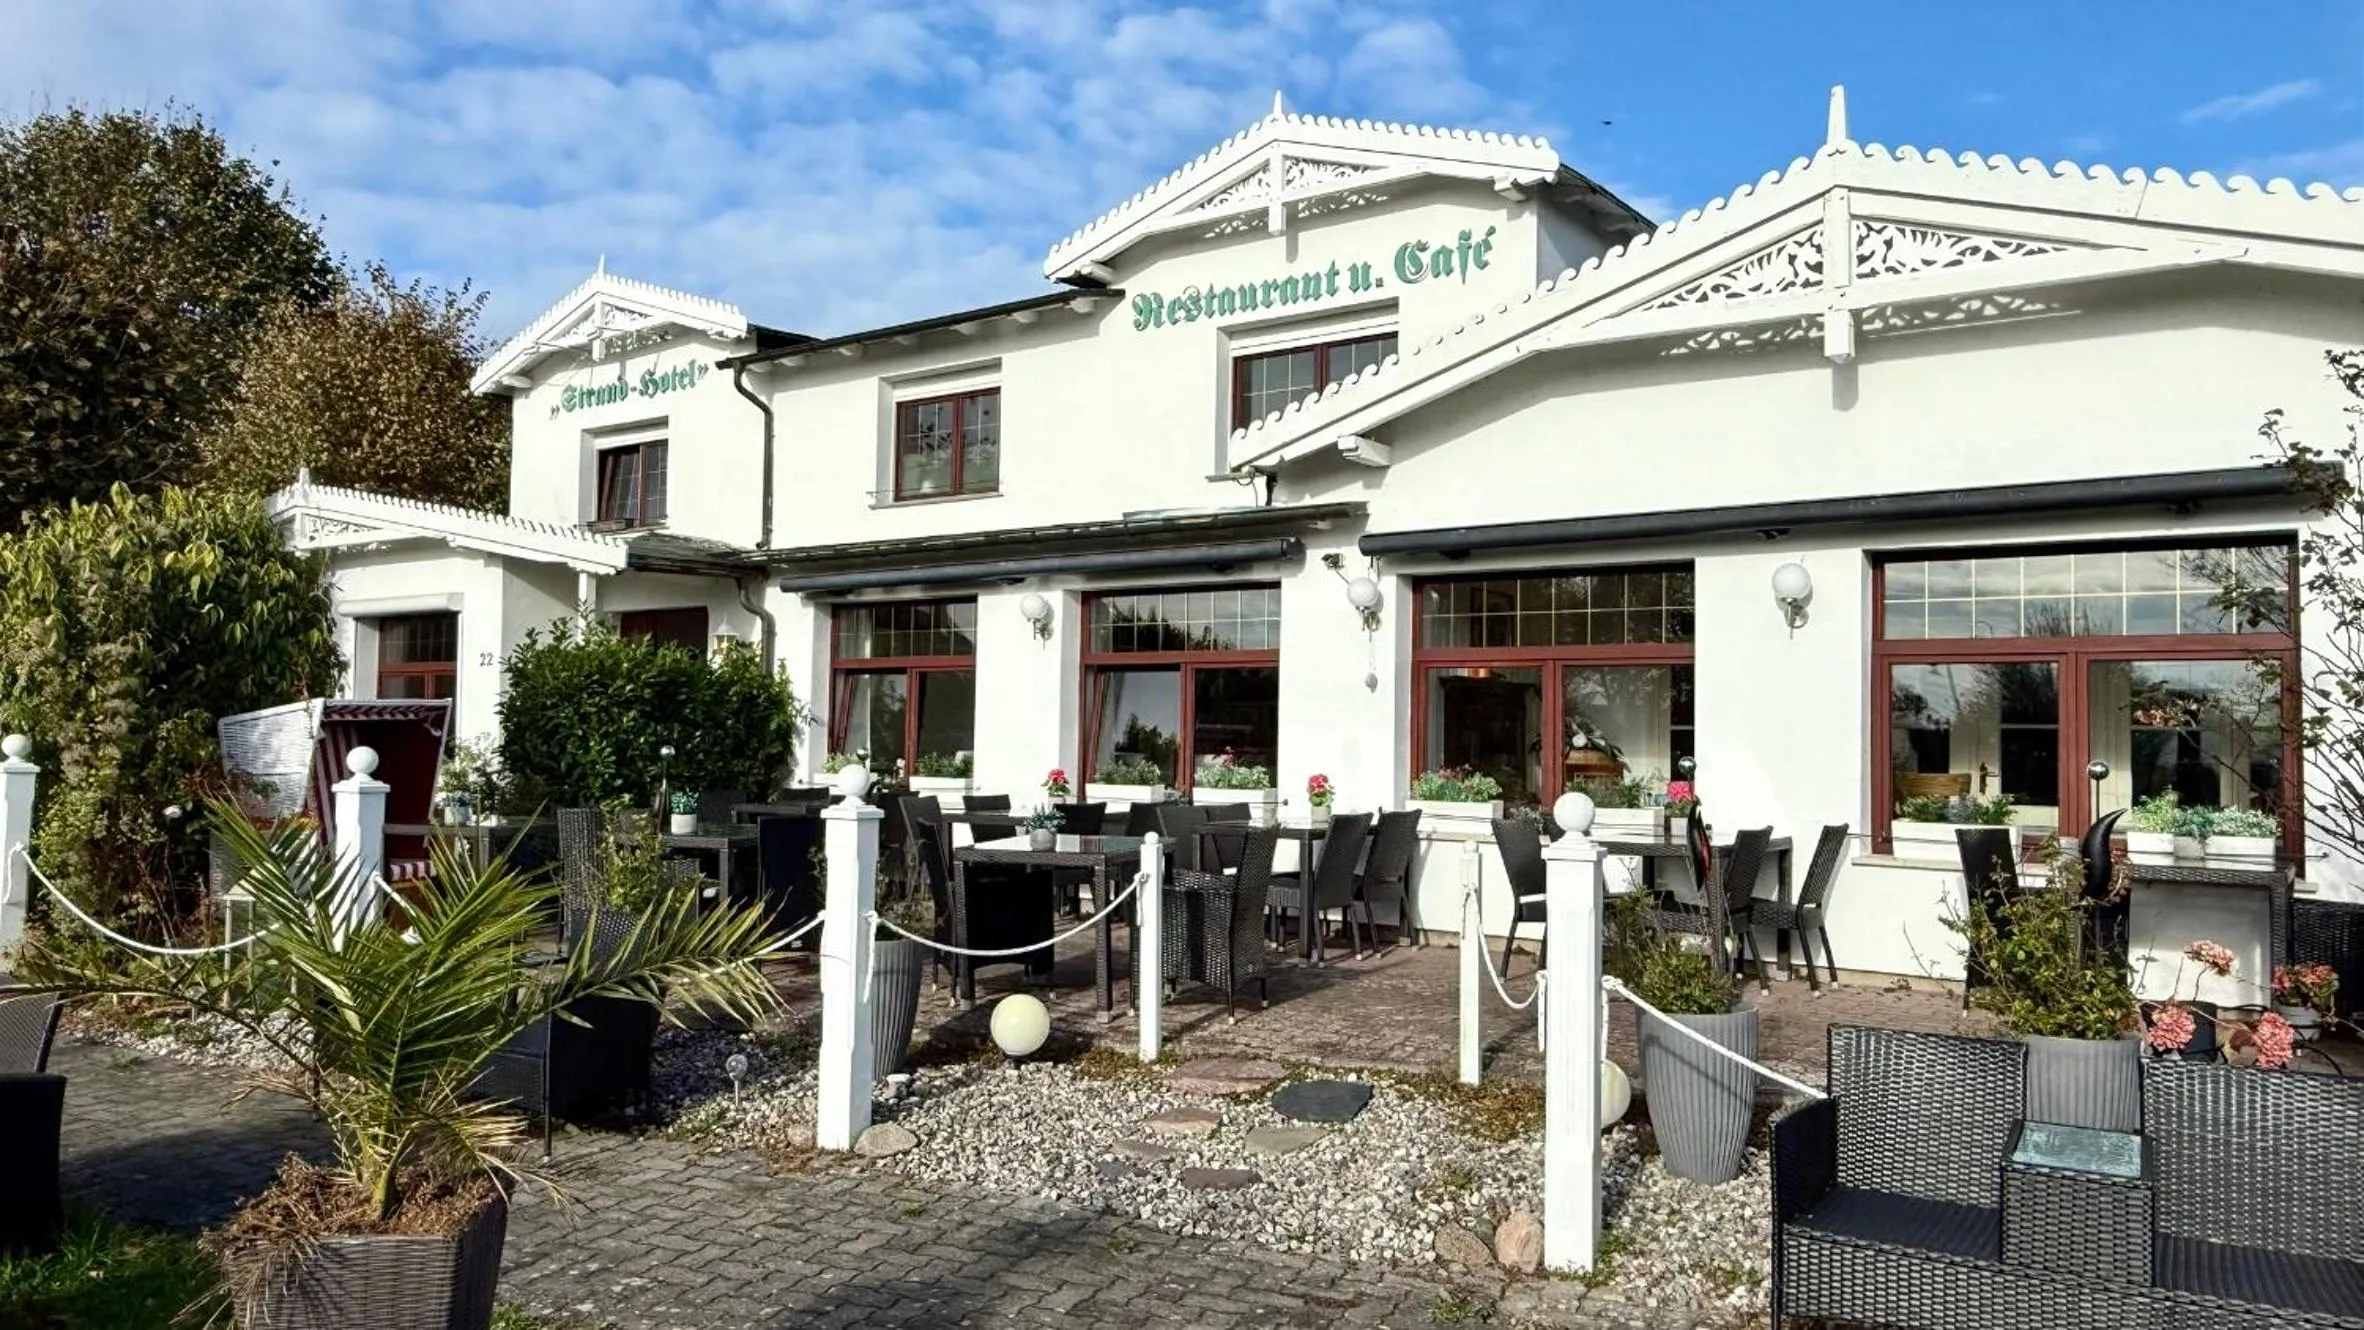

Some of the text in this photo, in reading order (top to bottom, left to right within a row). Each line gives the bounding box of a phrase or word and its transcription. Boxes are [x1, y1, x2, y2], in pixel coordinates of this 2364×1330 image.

[1132, 225, 1496, 331] Restaurant u. Café
[480, 652, 494, 667] 22
